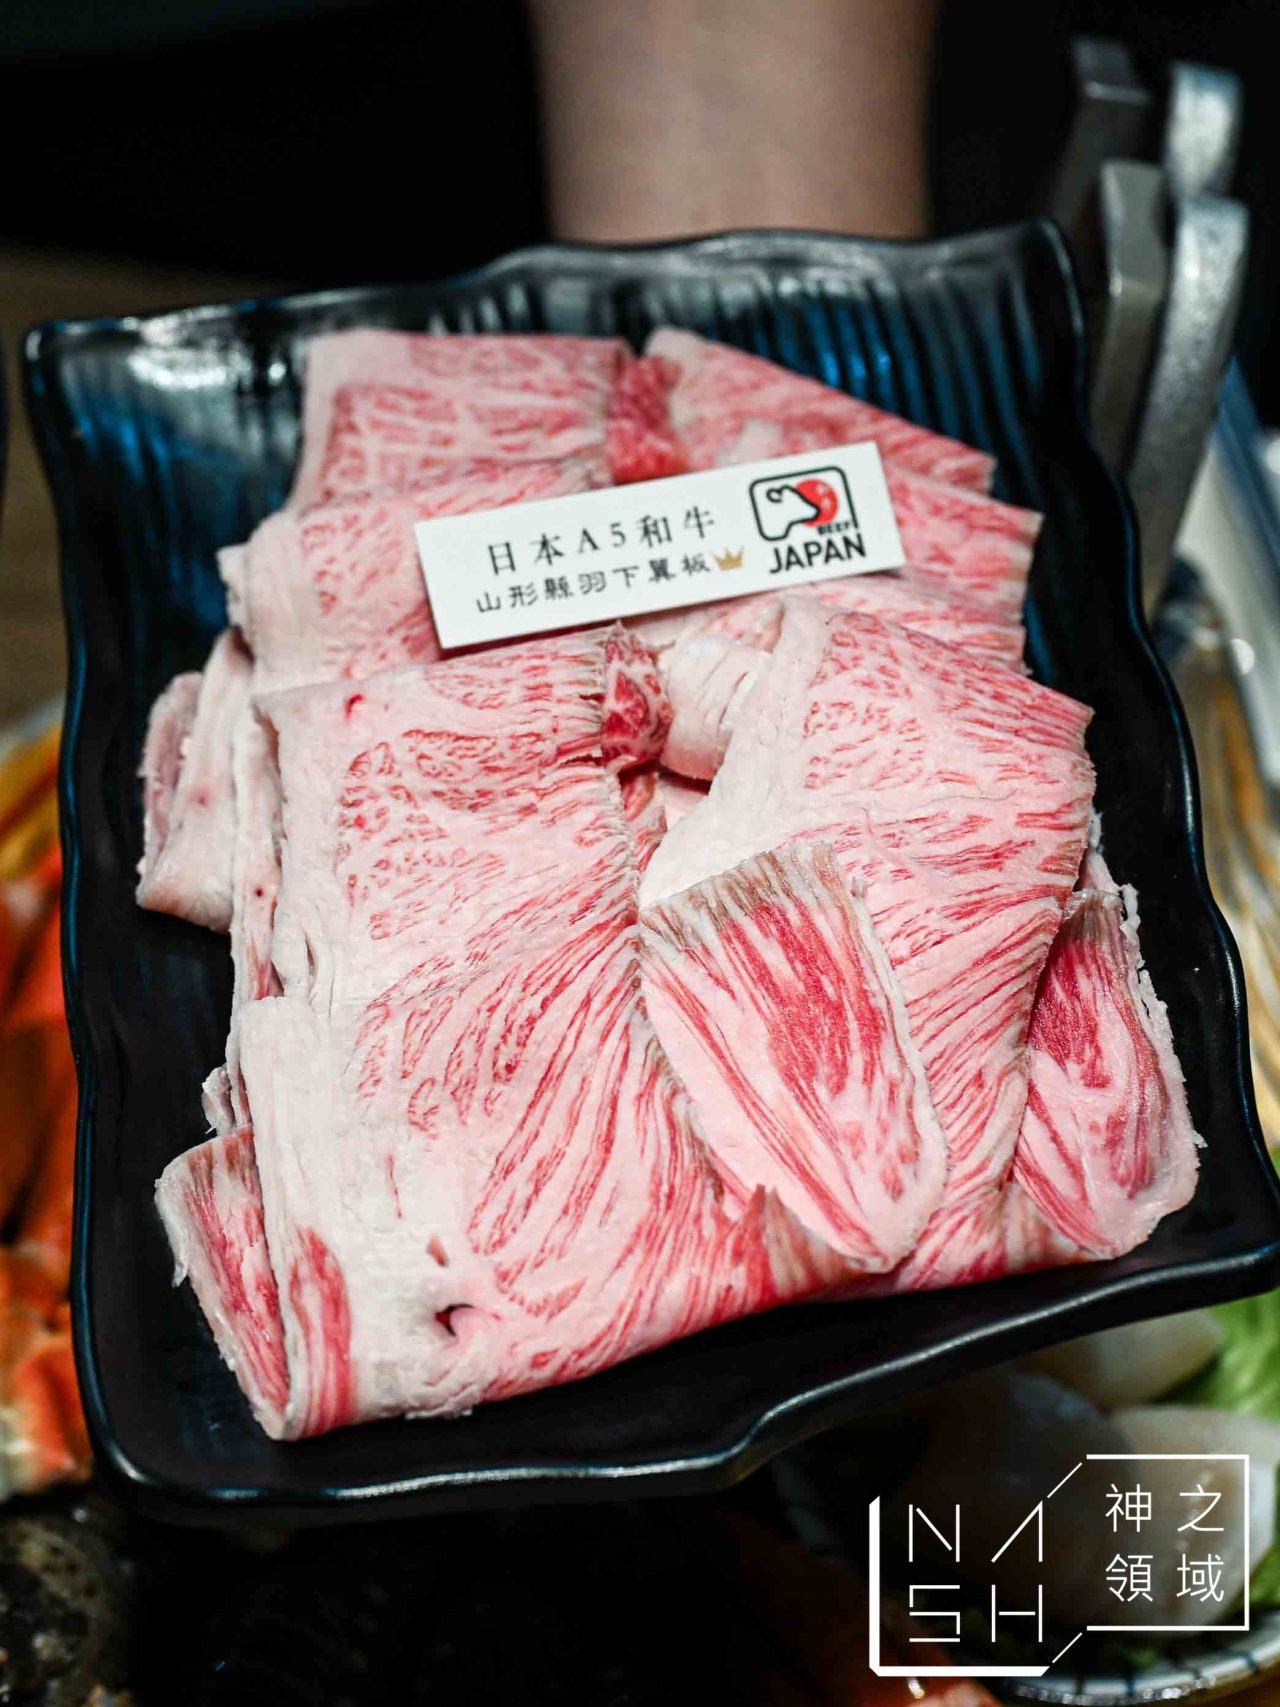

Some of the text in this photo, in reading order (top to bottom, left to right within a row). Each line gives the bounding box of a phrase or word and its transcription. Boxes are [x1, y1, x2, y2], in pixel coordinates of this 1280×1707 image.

[487, 505, 715, 576] 日本A5和牛
[768, 532, 866, 574] JAPAN
[816, 521, 853, 536] BEEF
[475, 552, 712, 613] 山形縣羽下翼板
